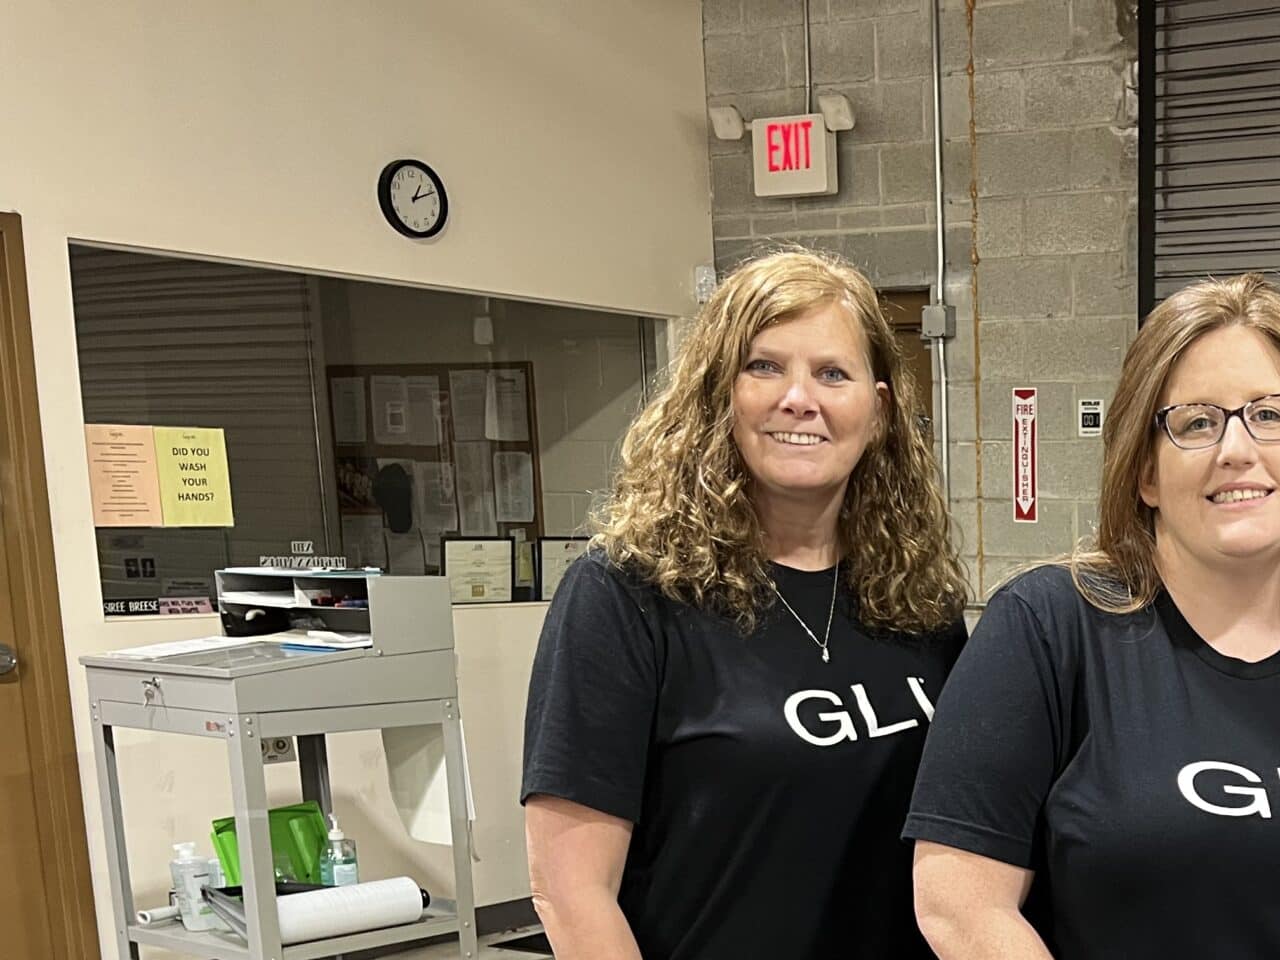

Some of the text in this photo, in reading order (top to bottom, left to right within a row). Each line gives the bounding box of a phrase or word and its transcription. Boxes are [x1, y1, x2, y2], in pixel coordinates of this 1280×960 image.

[767, 121, 812, 172] EXIT
[407, 170, 416, 178] 12
[1016, 404, 1033, 415] FIRE
[172, 447, 209, 457] DID YOU
[1021, 418, 1029, 502] EXTINGUISHER
[178, 463, 207, 471] WASH
[182, 478, 208, 486] YOUR
[177, 493, 214, 502] HANDS?
[784, 677, 935, 747] GLI
